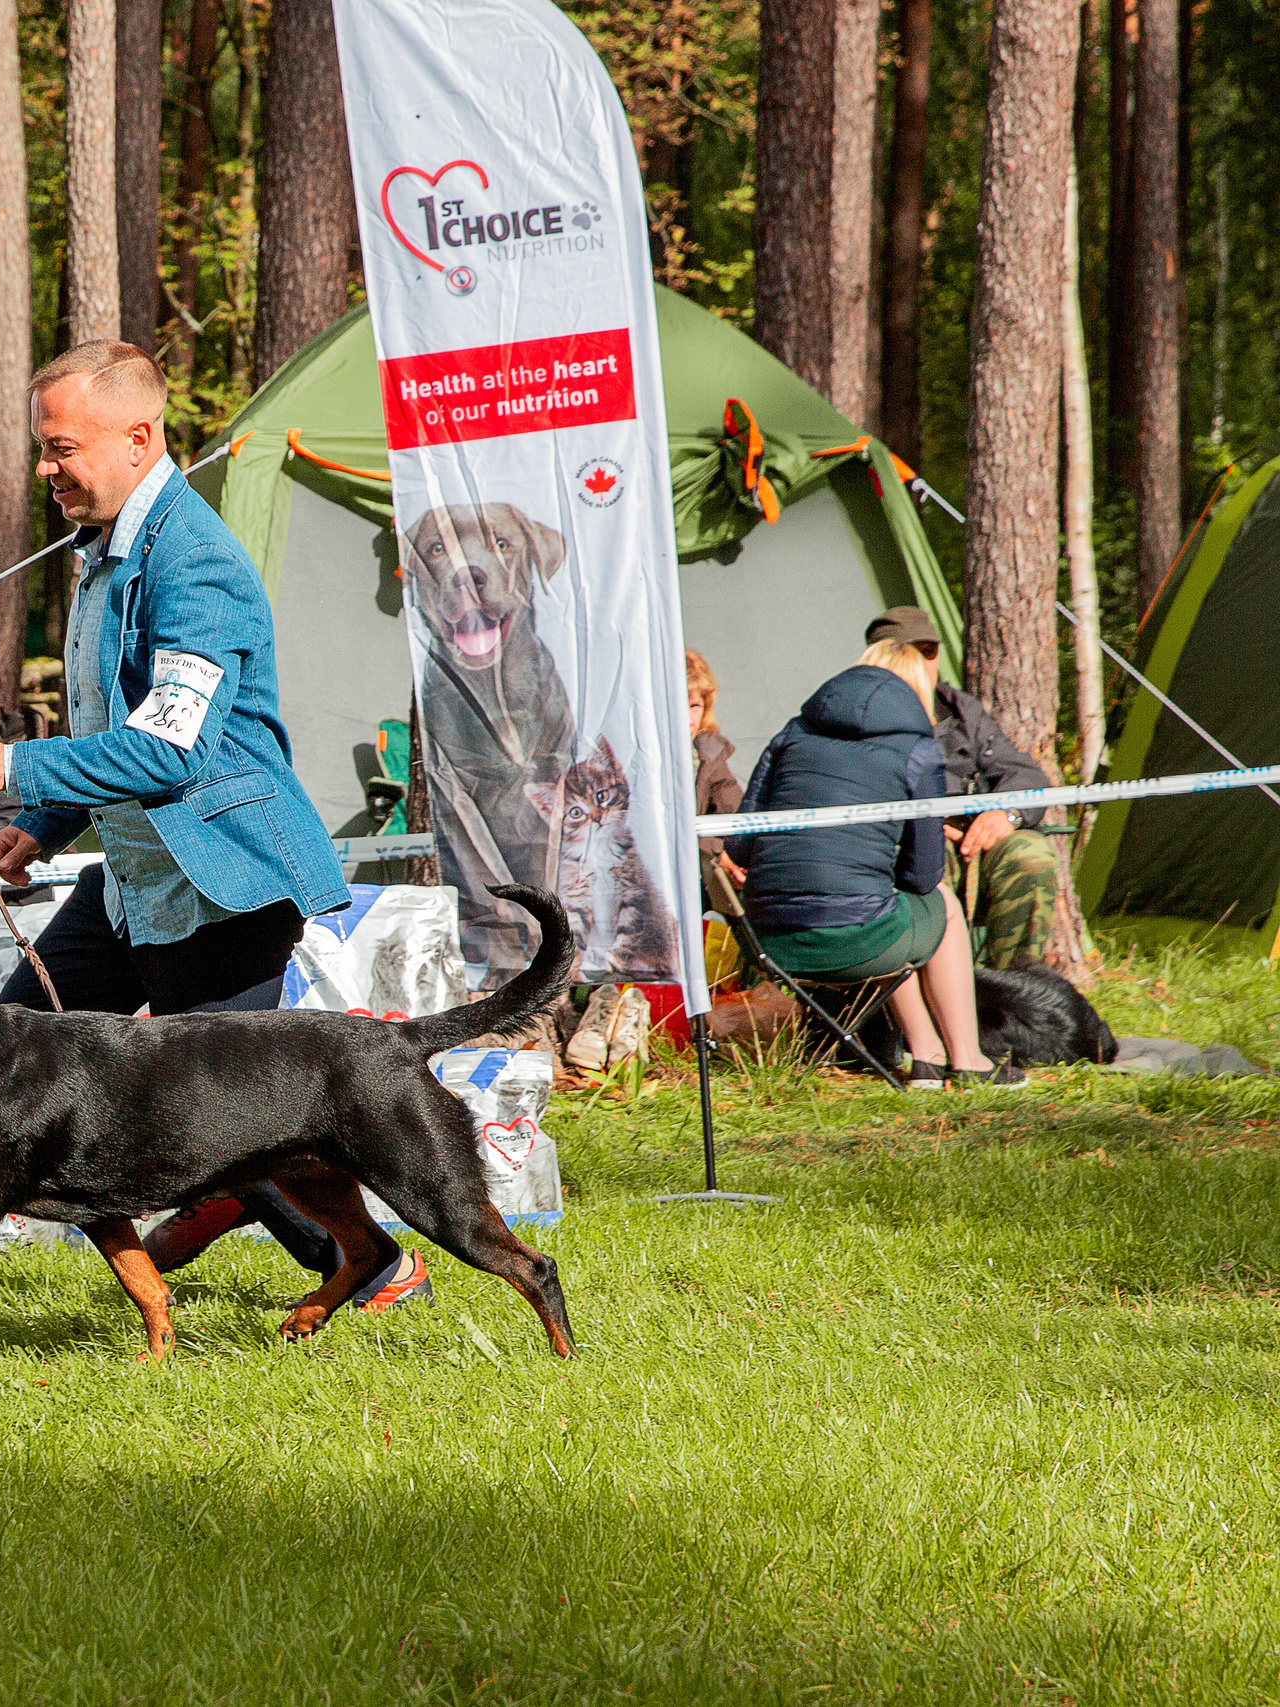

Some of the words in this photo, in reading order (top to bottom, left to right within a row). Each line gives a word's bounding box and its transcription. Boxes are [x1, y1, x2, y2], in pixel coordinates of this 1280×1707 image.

[442, 206, 563, 248] CHOICE
[487, 233, 605, 263] NUTRITION
[400, 372, 476, 400] Health
[482, 370, 504, 390] at
[510, 365, 547, 386] the
[553, 354, 618, 380] heart
[425, 403, 445, 425] of
[452, 403, 490, 422] our
[496, 387, 599, 417] nutrition
